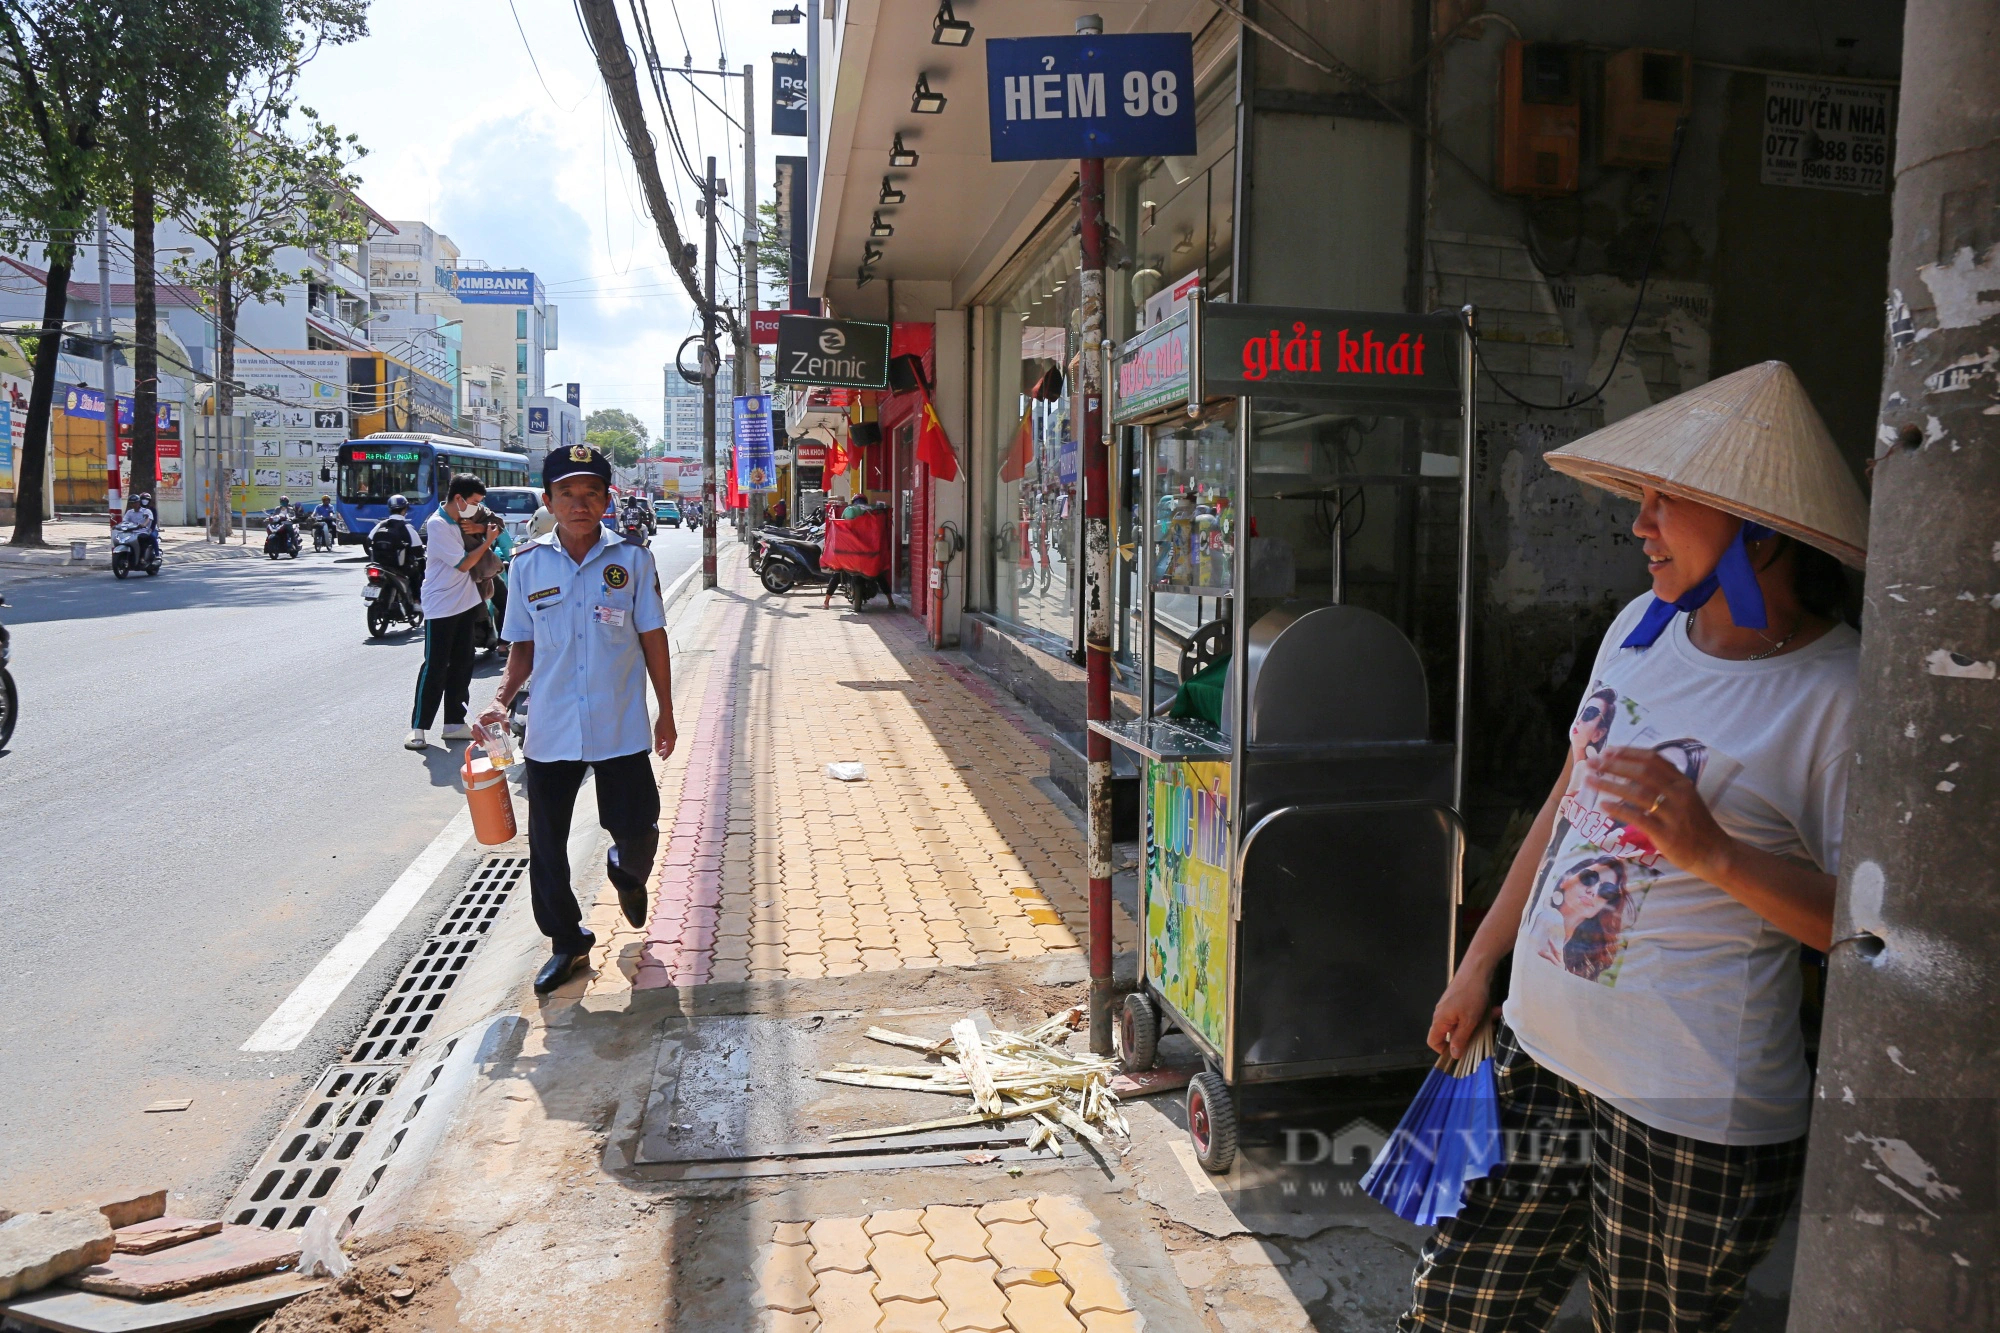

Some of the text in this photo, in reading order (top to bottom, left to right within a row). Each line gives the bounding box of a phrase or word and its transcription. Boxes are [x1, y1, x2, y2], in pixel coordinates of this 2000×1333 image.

[1004, 56, 1178, 120] HẺM 98
[1848, 97, 1886, 134] NHÀ
[1766, 134, 1799, 158] 077
[1852, 144, 1885, 166] 656
[1802, 162, 1831, 180] 0906
[1834, 166, 1857, 182] 353
[1860, 168, 1883, 185] 772
[790, 352, 866, 380] Zennic
[1156, 331, 1183, 382] MÍA
[1242, 322, 1426, 381] giải khát
[531, 421, 545, 430] PNJ
